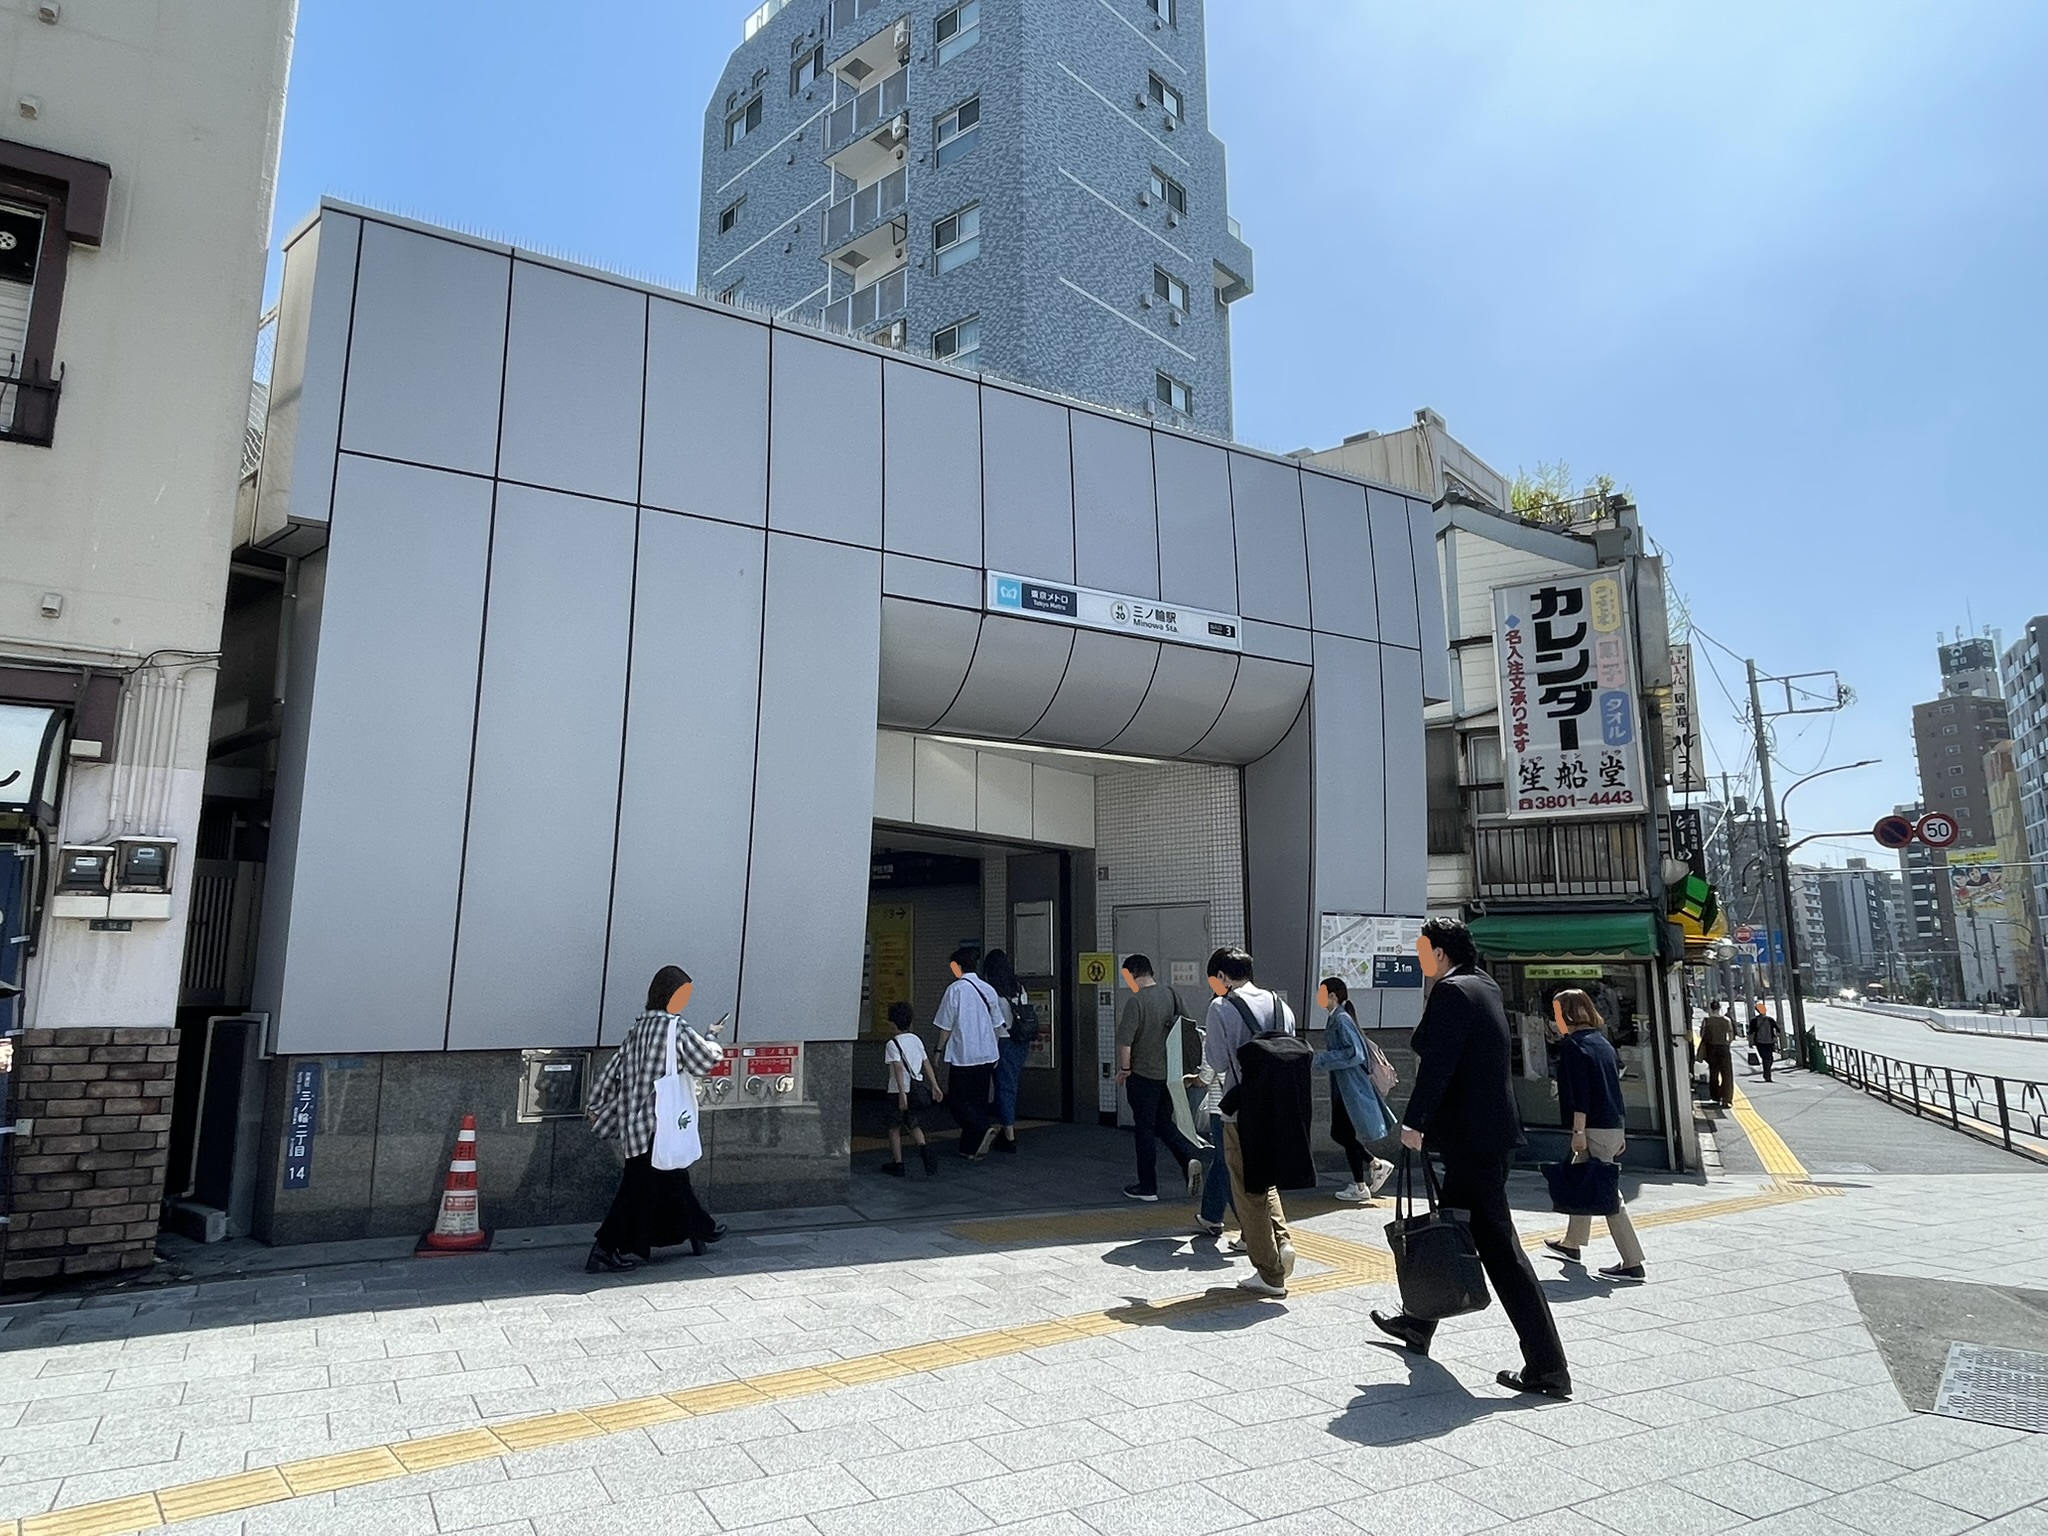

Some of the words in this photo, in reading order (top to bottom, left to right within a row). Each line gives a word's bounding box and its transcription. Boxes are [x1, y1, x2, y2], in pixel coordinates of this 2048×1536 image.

[1030, 589, 1069, 604] 東京メトロ
[1033, 599, 1049, 608] Tokyo
[1049, 602, 1067, 611] Metro
[1117, 604, 1123, 612] H
[1115, 611, 1126, 620] 20
[1133, 605, 1177, 624] 三ノ輪駅
[1133, 618, 1164, 630] Minowa
[1165, 624, 1180, 633] Sta.
[1225, 625, 1232, 636] 3
[1530, 586, 1598, 751] カレンダー
[1504, 629, 1531, 753] 名入注文承ります
[1605, 697, 1626, 740] タオル
[1518, 755, 1626, 794] 笙船堂
[1535, 790, 1634, 810] 3801-4443
[1926, 822, 1950, 838] 50
[1393, 962, 1412, 973] 3.1m
[294, 1090, 312, 1157] 三ノ輪二丁目
[289, 1166, 305, 1180] 14
